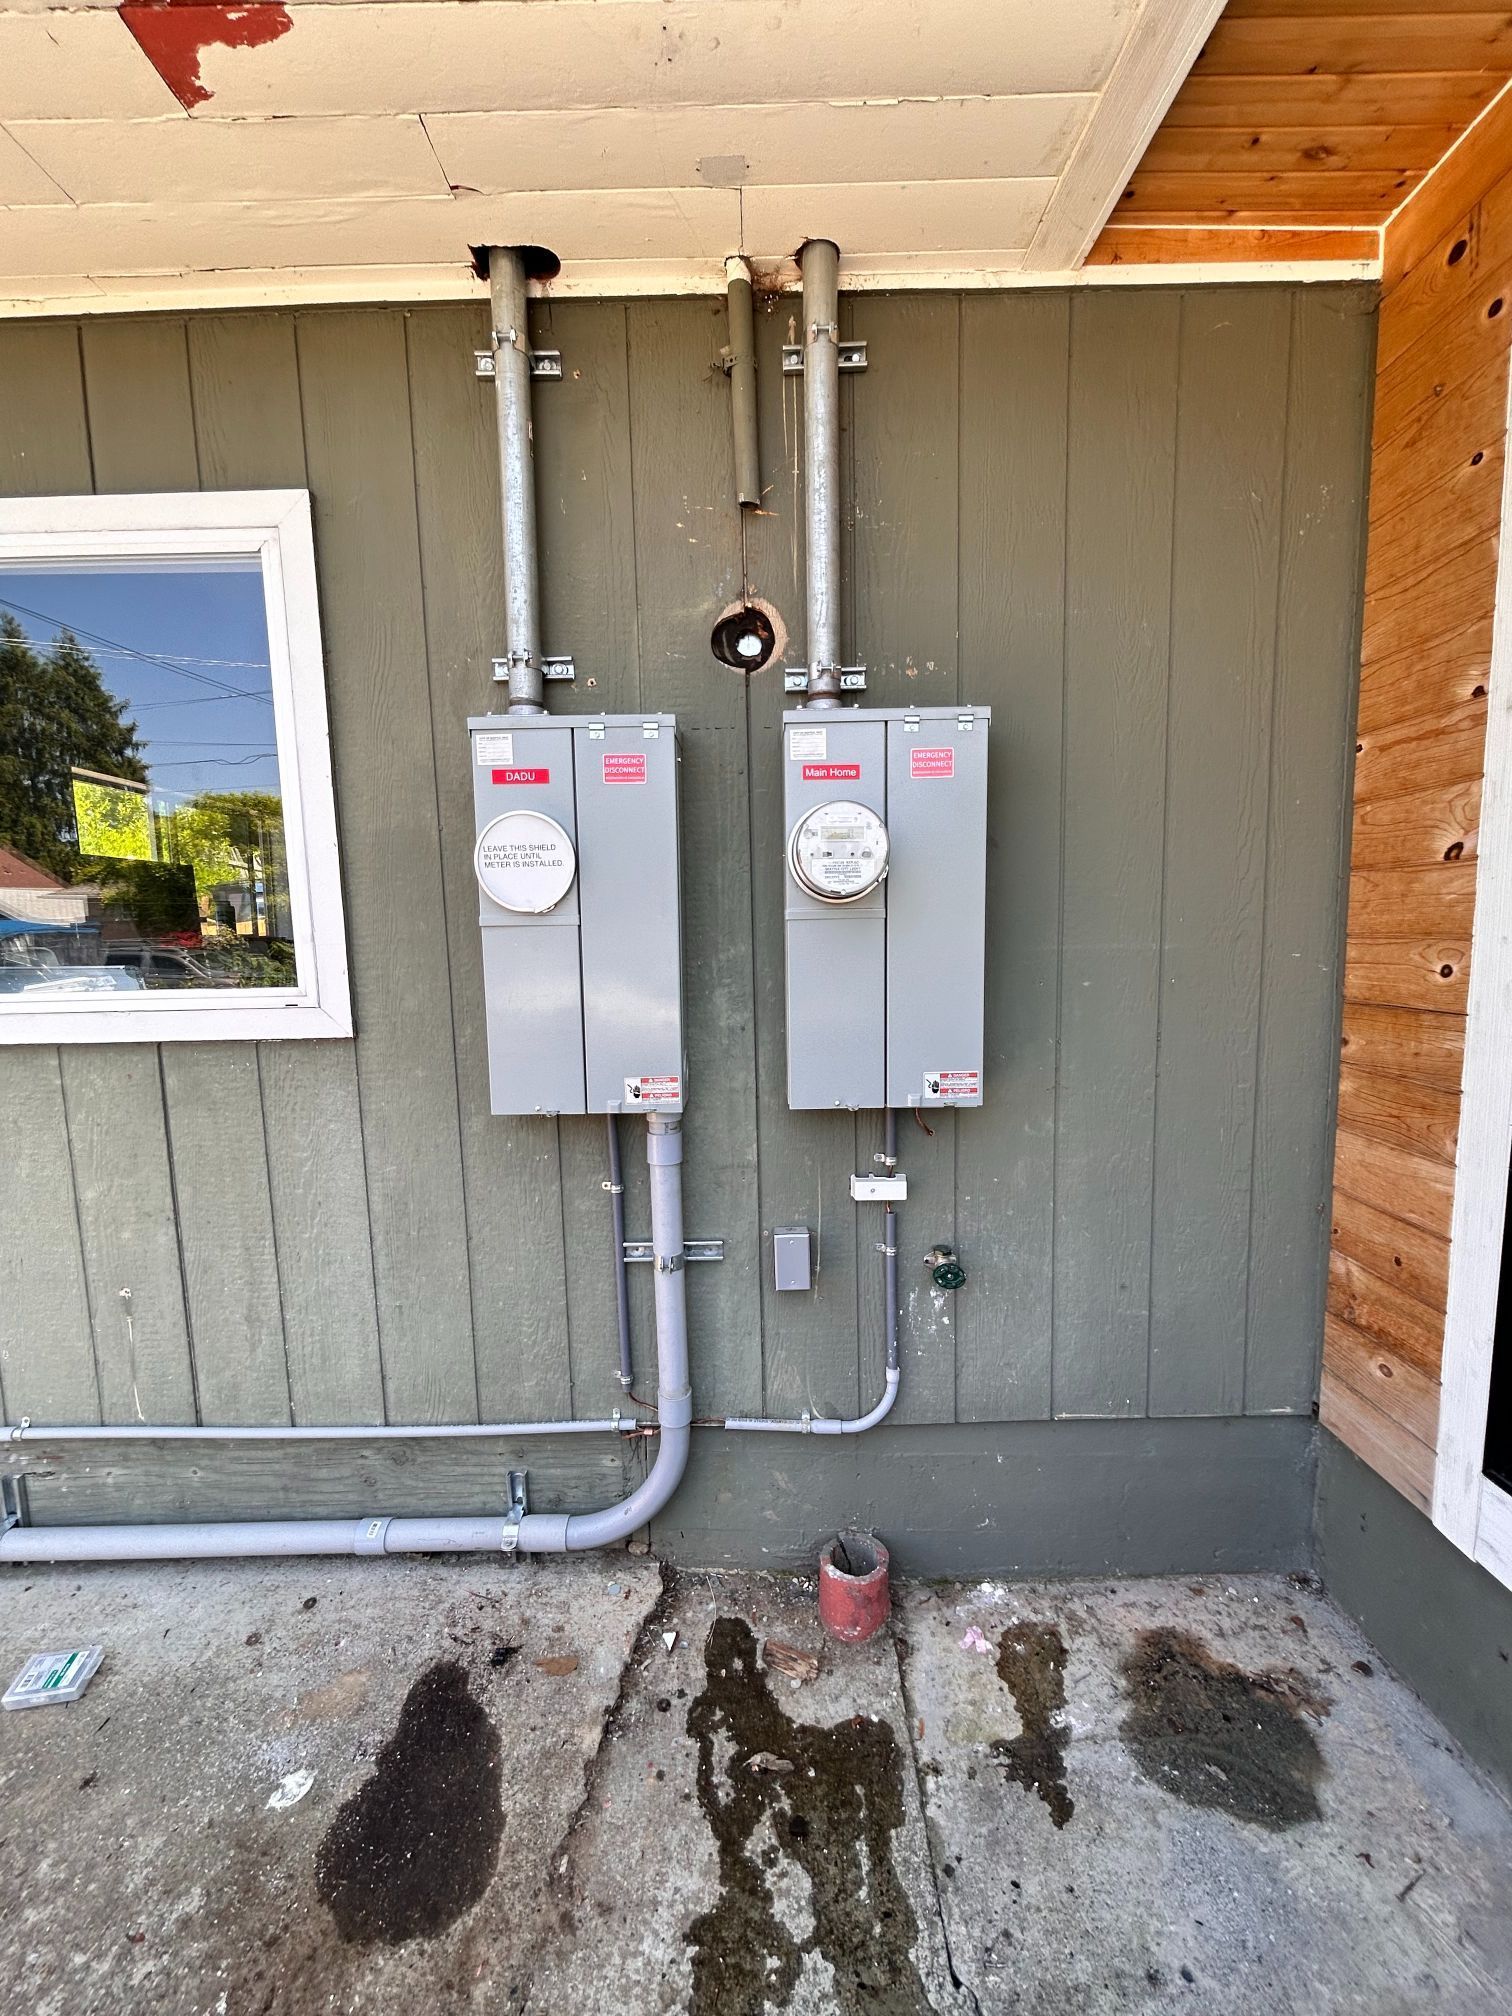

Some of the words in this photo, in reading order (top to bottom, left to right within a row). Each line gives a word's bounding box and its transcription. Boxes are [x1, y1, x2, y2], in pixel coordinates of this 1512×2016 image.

[604, 766, 645, 774] DISCONNECT
[805, 768, 828, 777] Main
[829, 767, 857, 777] Home
[506, 772, 535, 781] DADU
[509, 844, 527, 852] THIS
[528, 843, 557, 851] SHIELD
